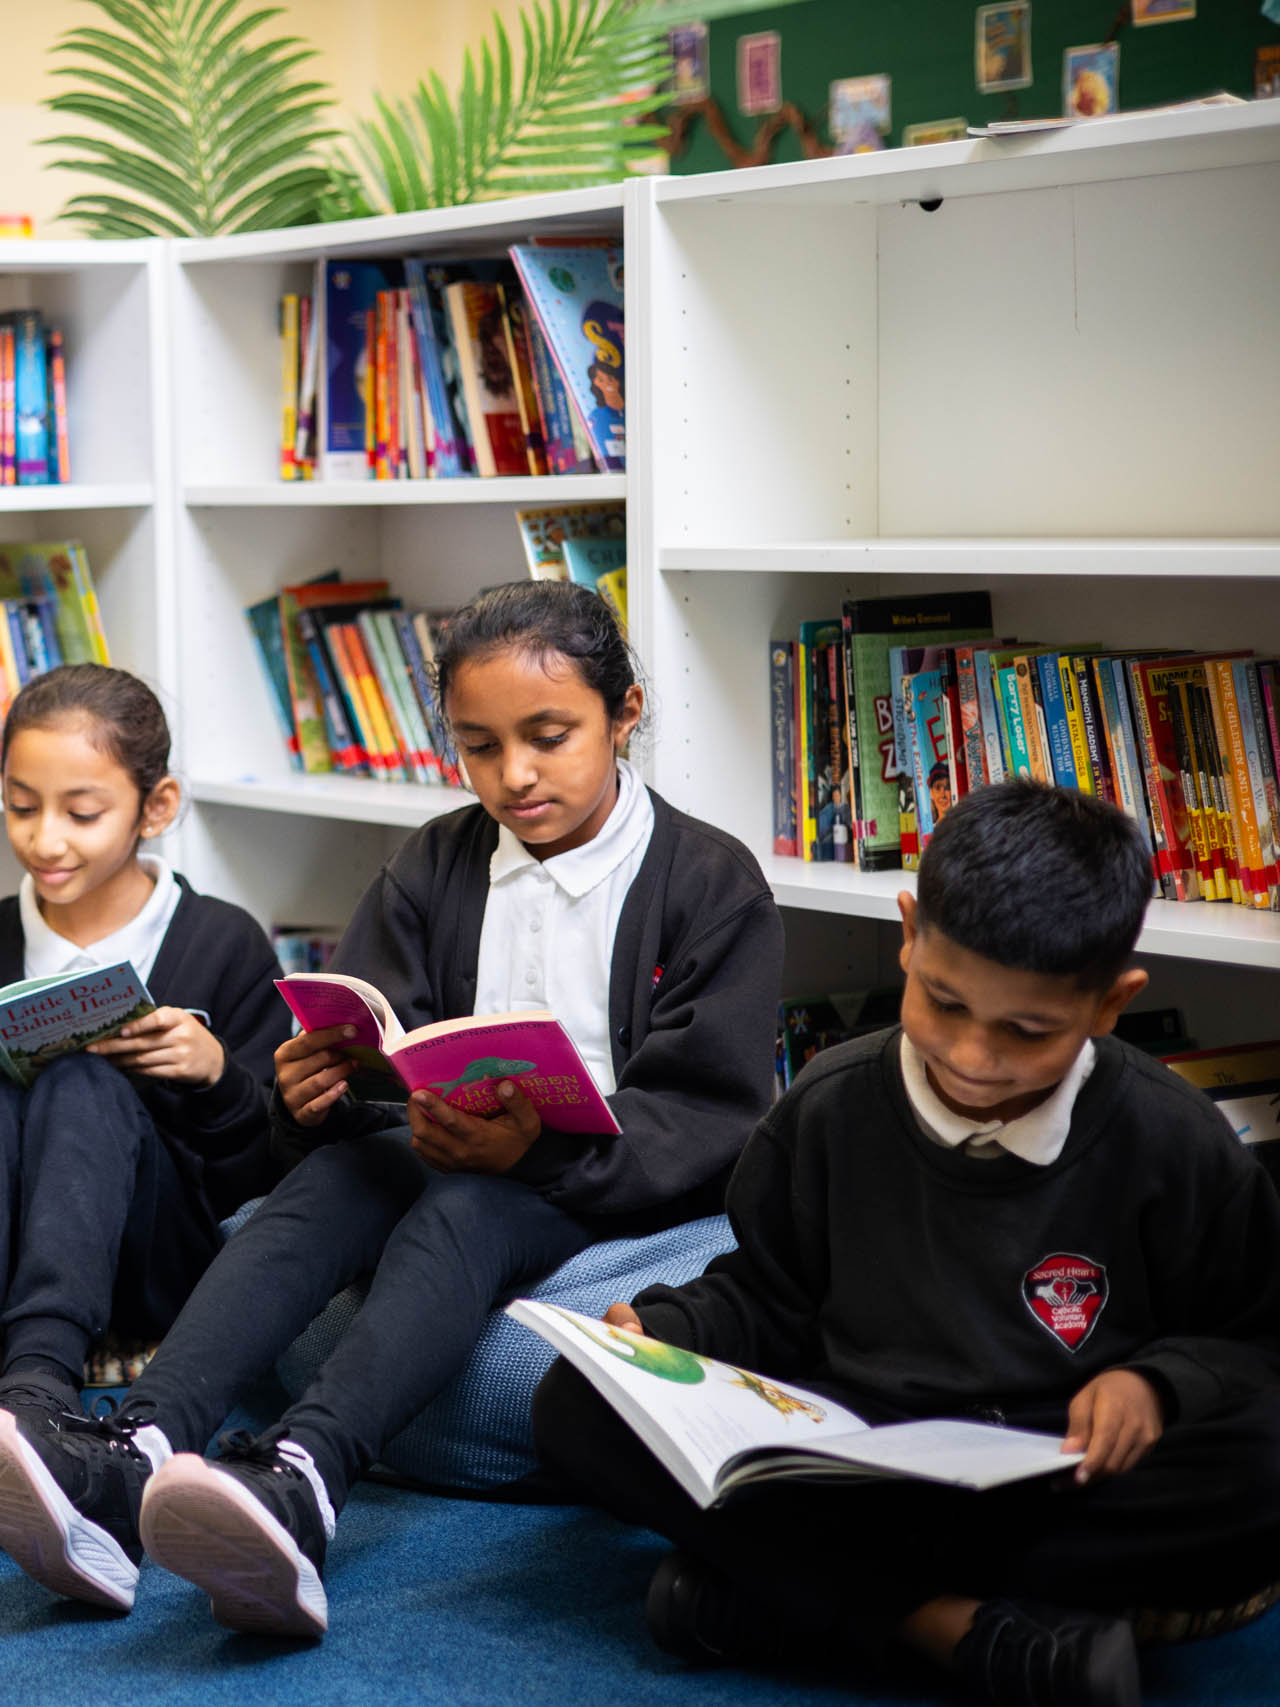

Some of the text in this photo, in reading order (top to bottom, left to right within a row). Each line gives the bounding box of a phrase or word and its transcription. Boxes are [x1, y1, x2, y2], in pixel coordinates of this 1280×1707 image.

[895, 697, 905, 722] STIG
[1006, 672, 1027, 756] Barry Loser
[1070, 718, 1080, 744] FATAL
[1058, 718, 1074, 774] GOODNIGHT
[1225, 700, 1245, 766] CHILDREN
[1236, 768, 1248, 798] AND
[1, 985, 135, 1040] Riding Hood
[7, 978, 113, 1022] Little Red
[404, 1038, 446, 1056] COLIN
[1066, 1266, 1096, 1278] Heart
[1051, 1305, 1082, 1316] Catholic
[1051, 1313, 1086, 1323] Voluntary
[1053, 1320, 1088, 1331] Academy
